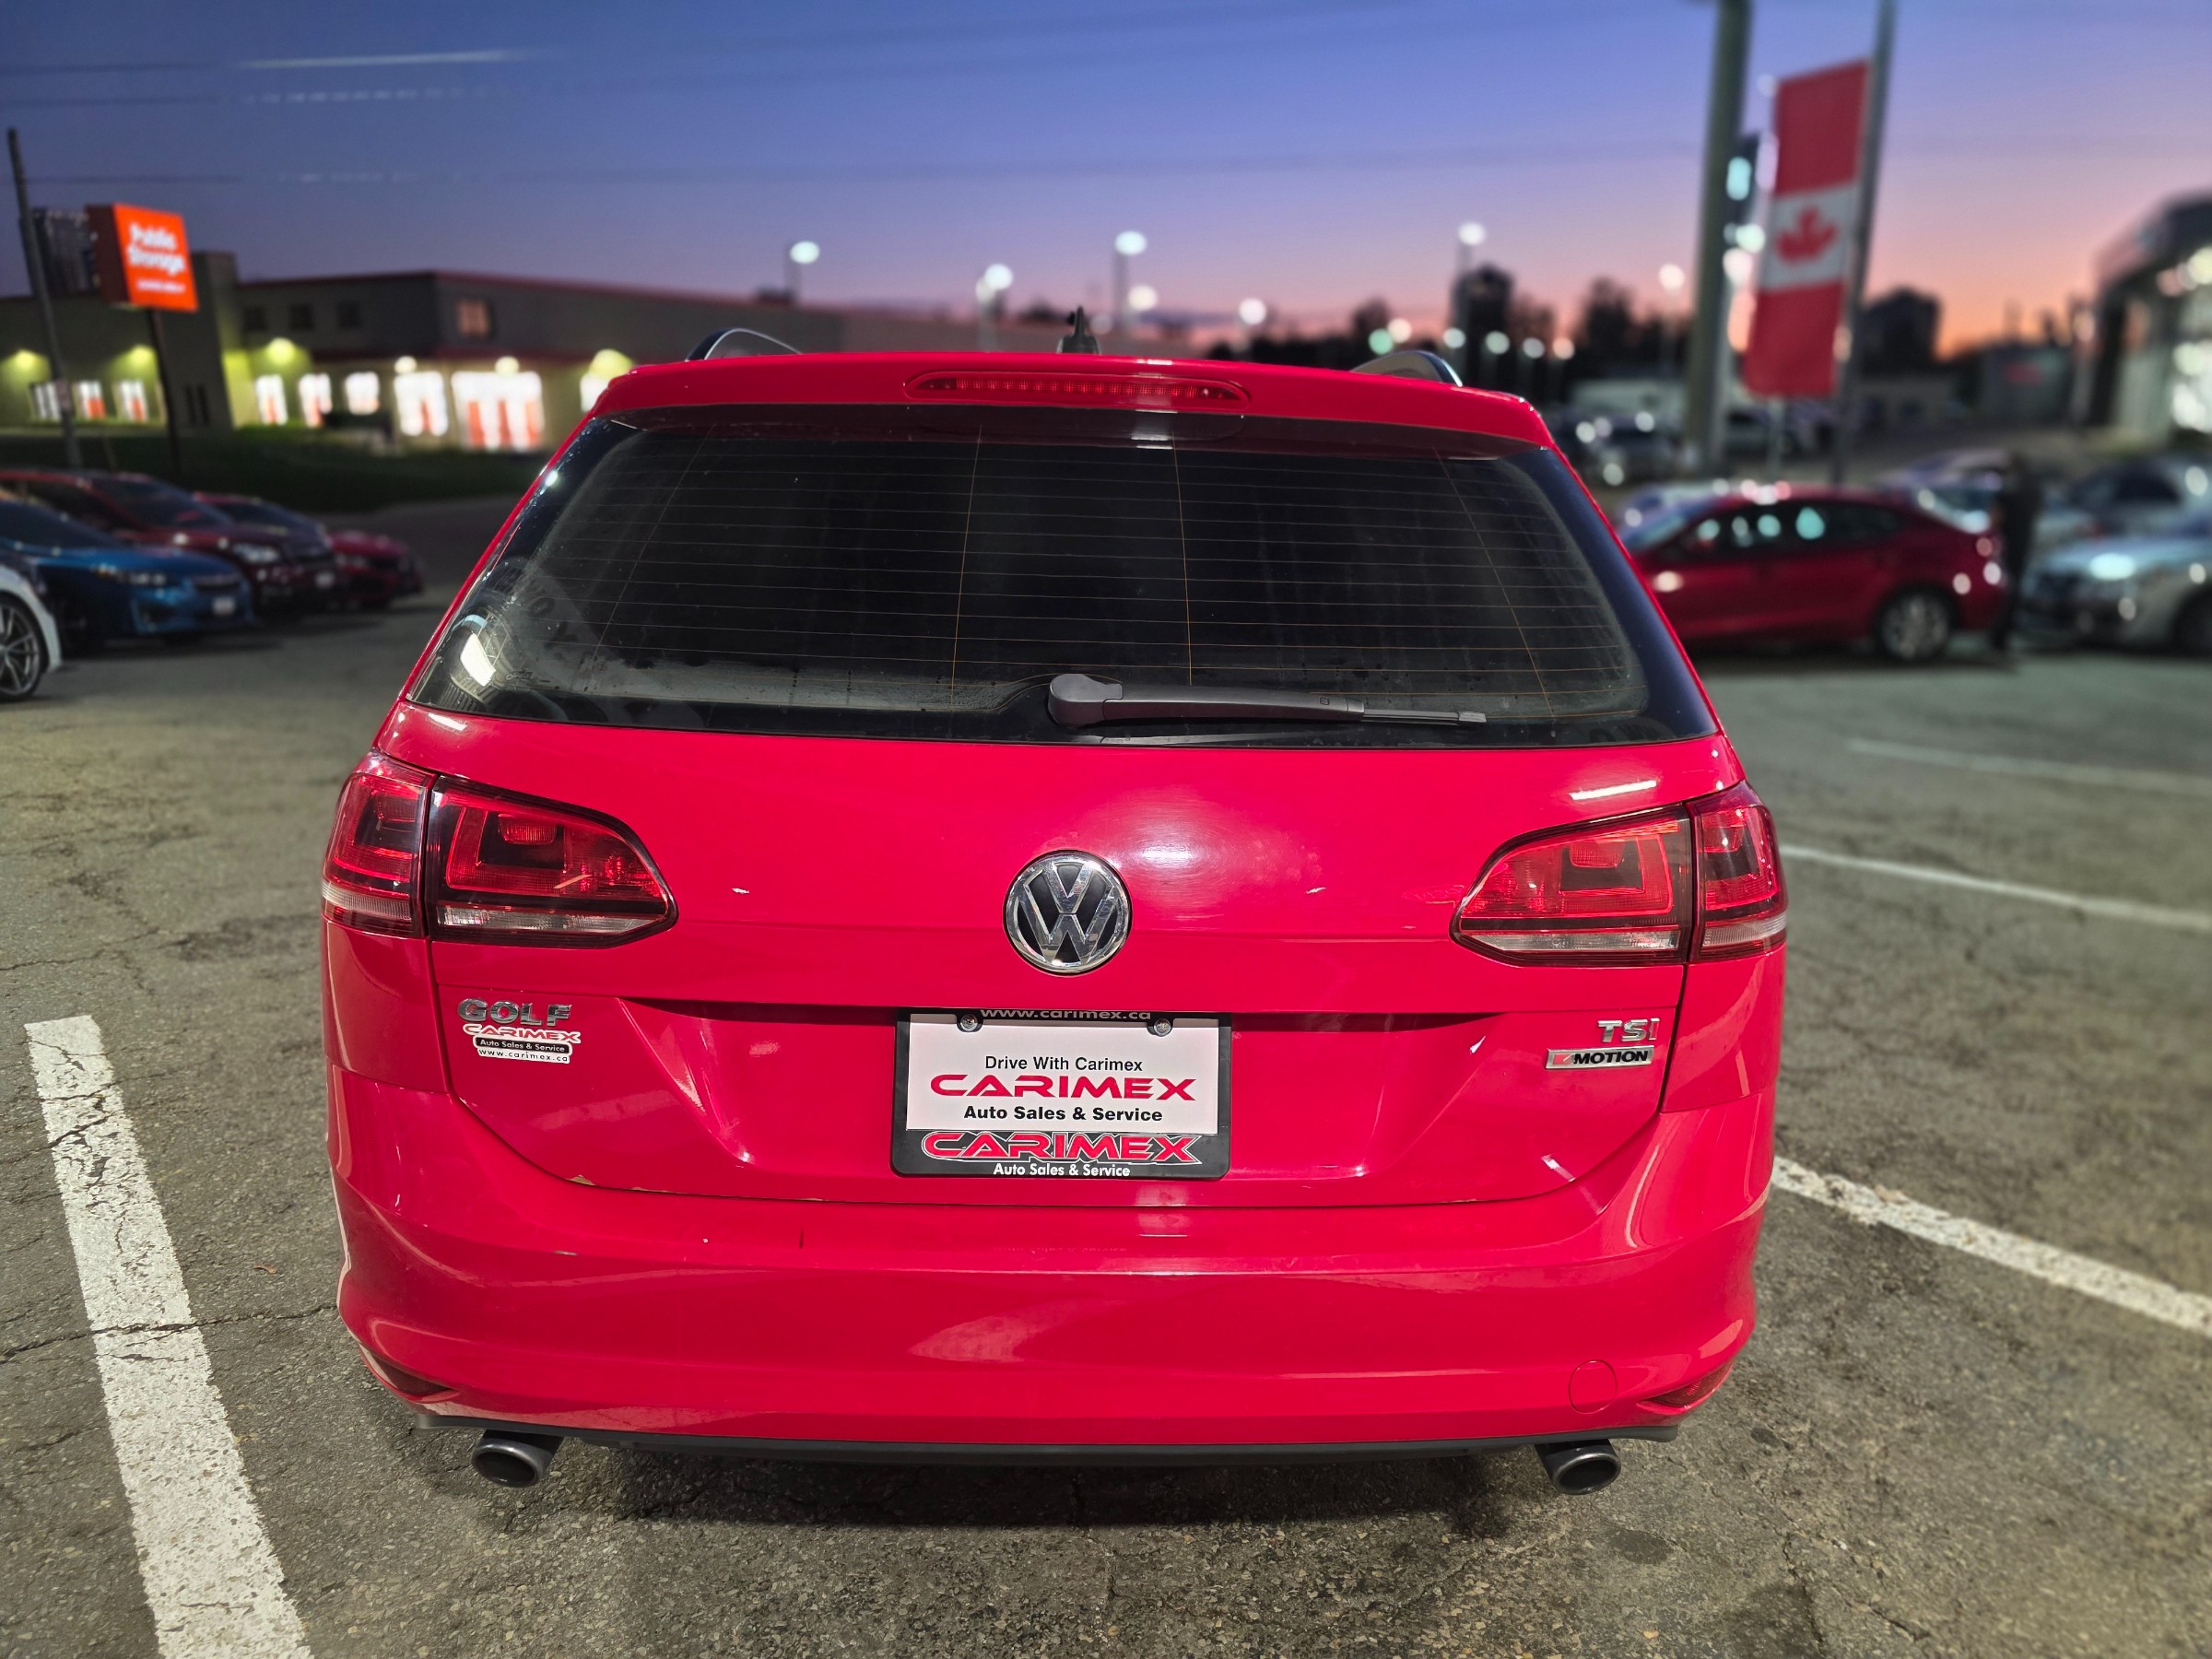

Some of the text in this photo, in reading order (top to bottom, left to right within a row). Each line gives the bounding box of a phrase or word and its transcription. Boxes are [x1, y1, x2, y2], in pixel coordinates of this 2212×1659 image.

[1011, 857, 1124, 968] VW
[457, 998, 572, 1027] GOLF
[981, 1009, 1151, 1020] www.carimex.ca
[464, 1025, 579, 1041] CARIMEX
[480, 1039, 500, 1047] Auto
[535, 1043, 565, 1053] Service
[478, 1049, 568, 1062] www.carimex.ca
[985, 1055, 1143, 1071] Drive With Carimex
[930, 1074, 1197, 1101] CARIMEX
[963, 1106, 1163, 1122] Auto Sales & Service
[924, 1132, 1200, 1162] CARIMEX
[994, 1163, 1131, 1177] Auto Sales & Service
